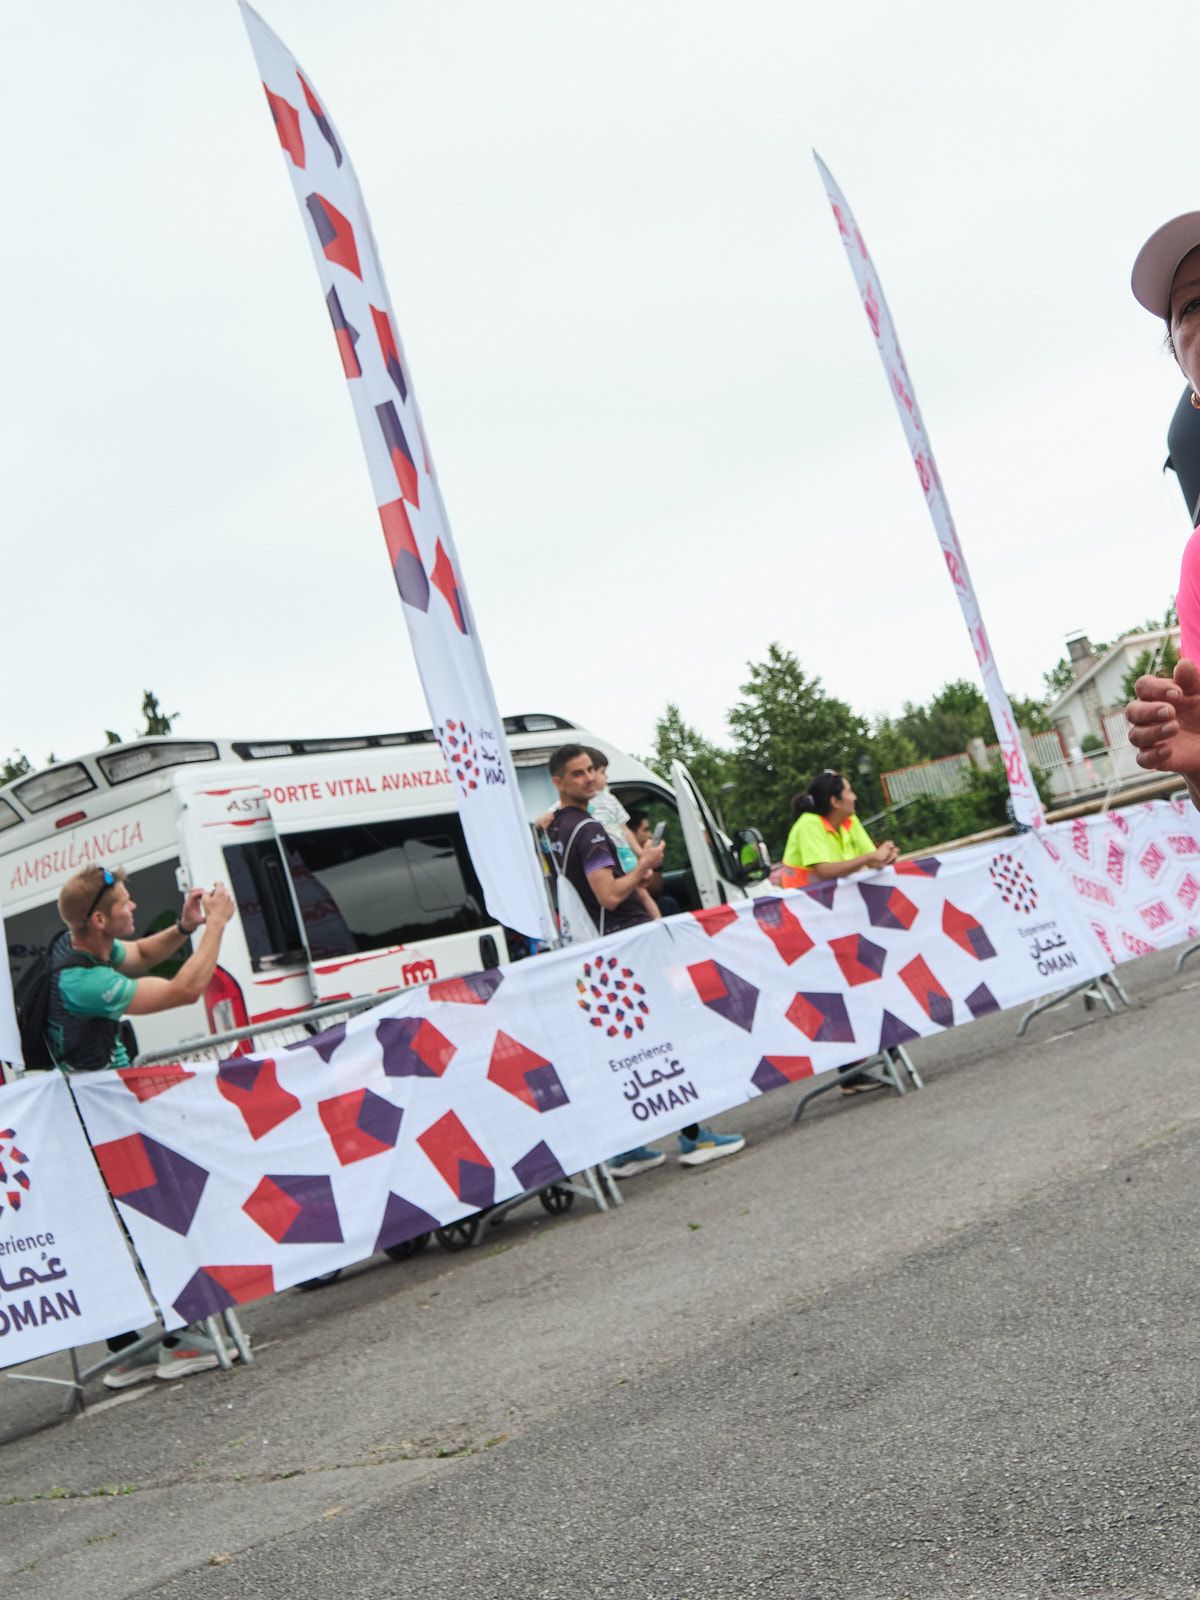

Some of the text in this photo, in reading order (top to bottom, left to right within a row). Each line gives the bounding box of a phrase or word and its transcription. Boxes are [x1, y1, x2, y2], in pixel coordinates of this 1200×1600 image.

[263, 783, 322, 804] PORTE
[325, 777, 376, 797] VITAL
[10, 820, 143, 890] AMBULANCIA
[1037, 951, 1078, 977] OMAN
[609, 1041, 674, 1073] Experience
[632, 1081, 699, 1122] OMAN
[0, 1232, 55, 1256] erience
